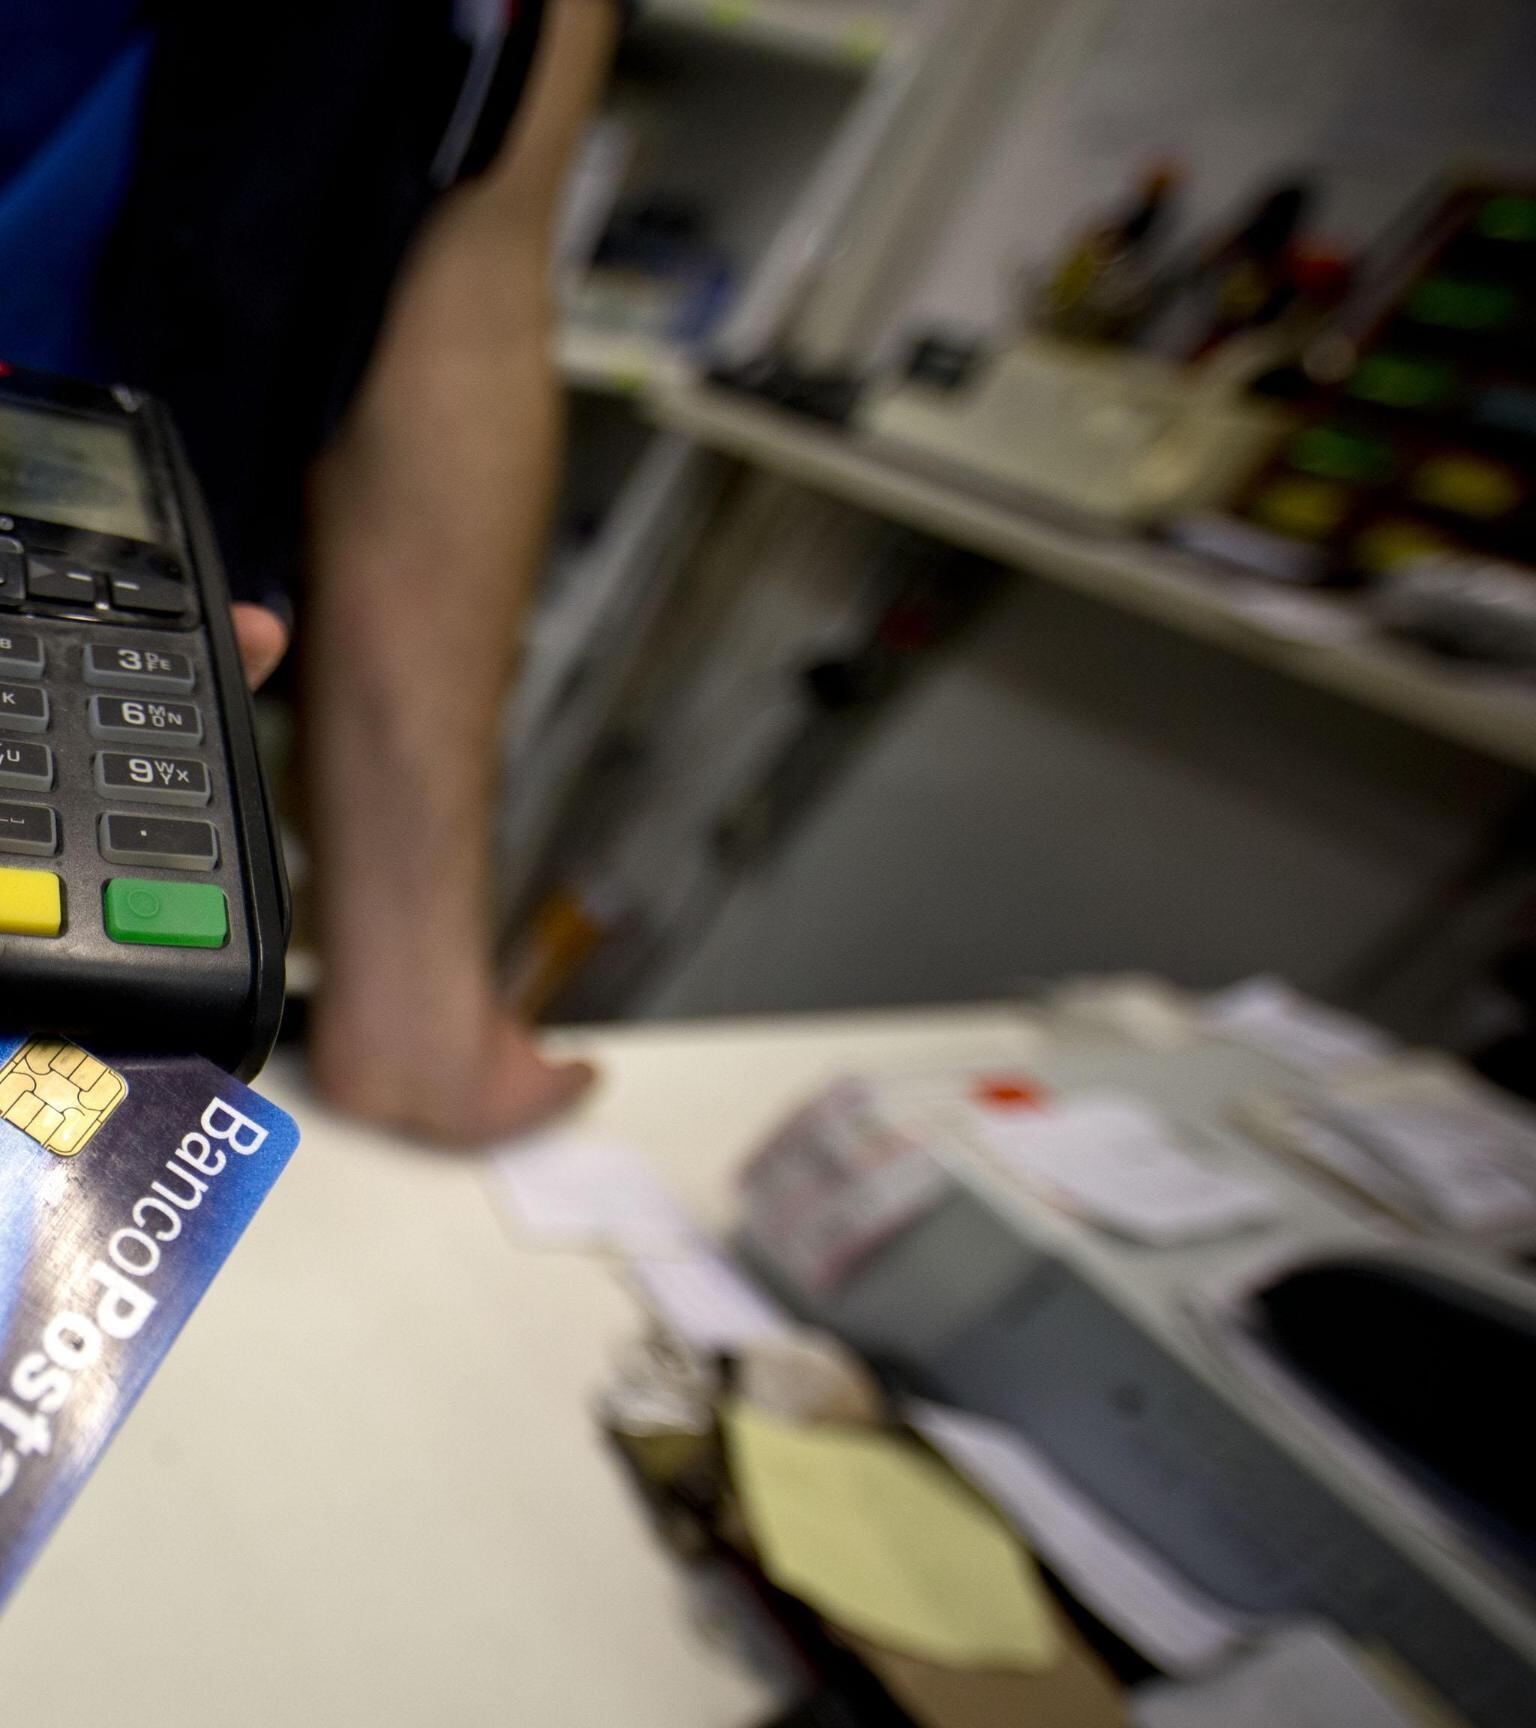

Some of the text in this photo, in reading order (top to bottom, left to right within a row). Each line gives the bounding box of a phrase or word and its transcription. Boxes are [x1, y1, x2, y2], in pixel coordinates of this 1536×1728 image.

[118, 650, 143, 670] 3
[121, 702, 146, 725] 6
[129, 758, 155, 783] 9
